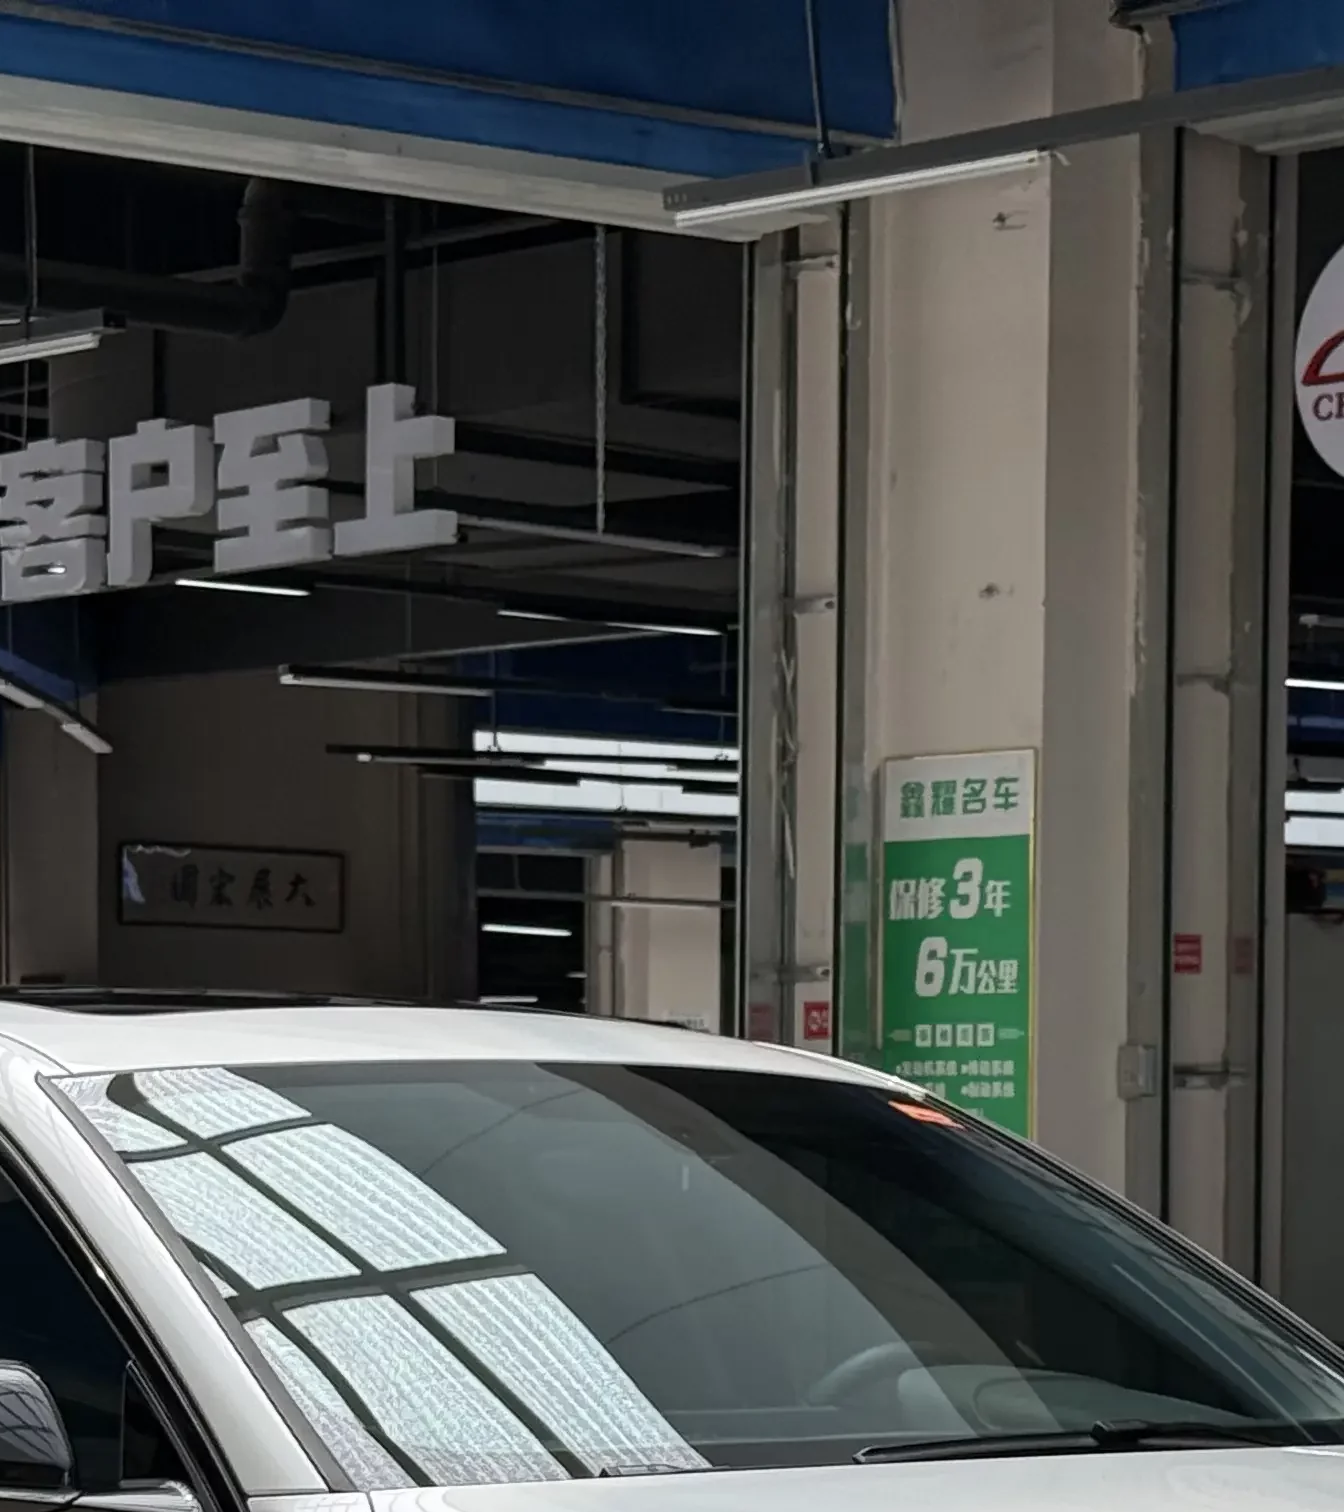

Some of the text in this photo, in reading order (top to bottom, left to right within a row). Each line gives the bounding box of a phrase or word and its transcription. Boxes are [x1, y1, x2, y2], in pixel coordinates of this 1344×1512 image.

[900, 776, 1019, 818] 鑫耀名车
[889, 857, 1011, 920] 保修3年
[915, 936, 1018, 997] 6万公里
